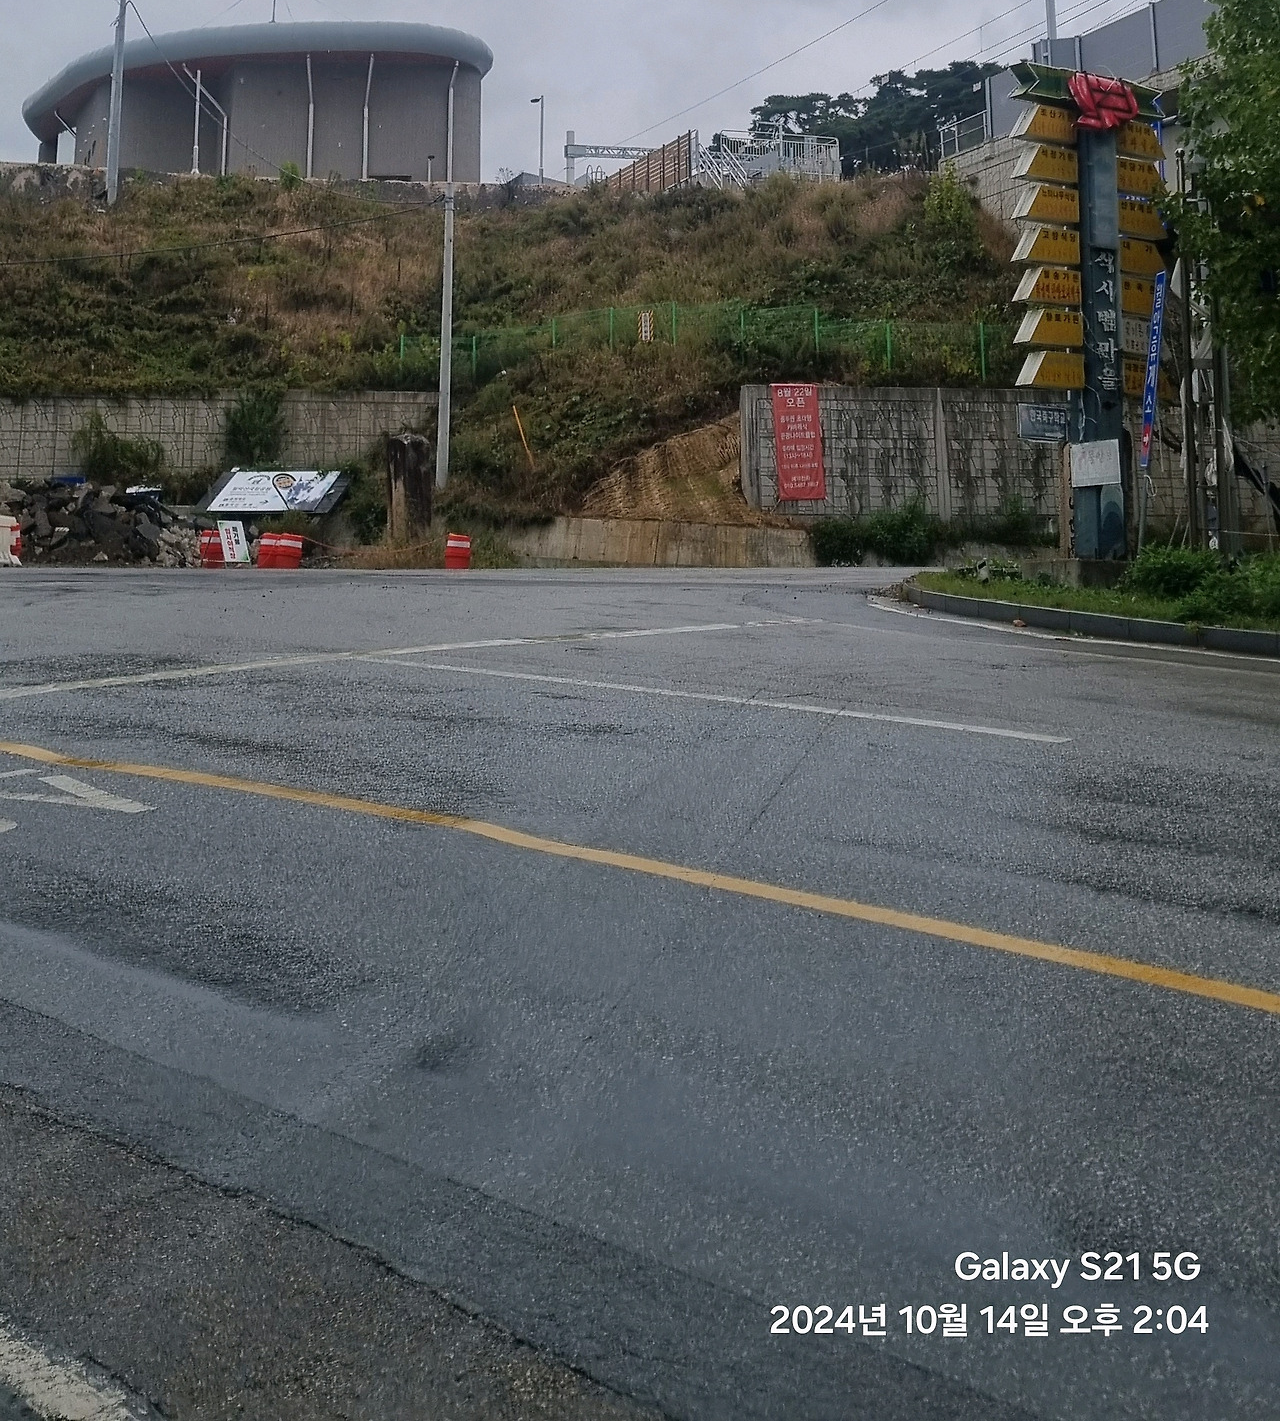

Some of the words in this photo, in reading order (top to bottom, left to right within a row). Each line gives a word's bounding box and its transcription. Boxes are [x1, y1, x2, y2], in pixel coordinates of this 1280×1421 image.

[1042, 230, 1076, 243] 고향식당
[777, 388, 791, 398] 8월
[794, 387, 812, 397] 22일
[786, 397, 805, 408] 오픈
